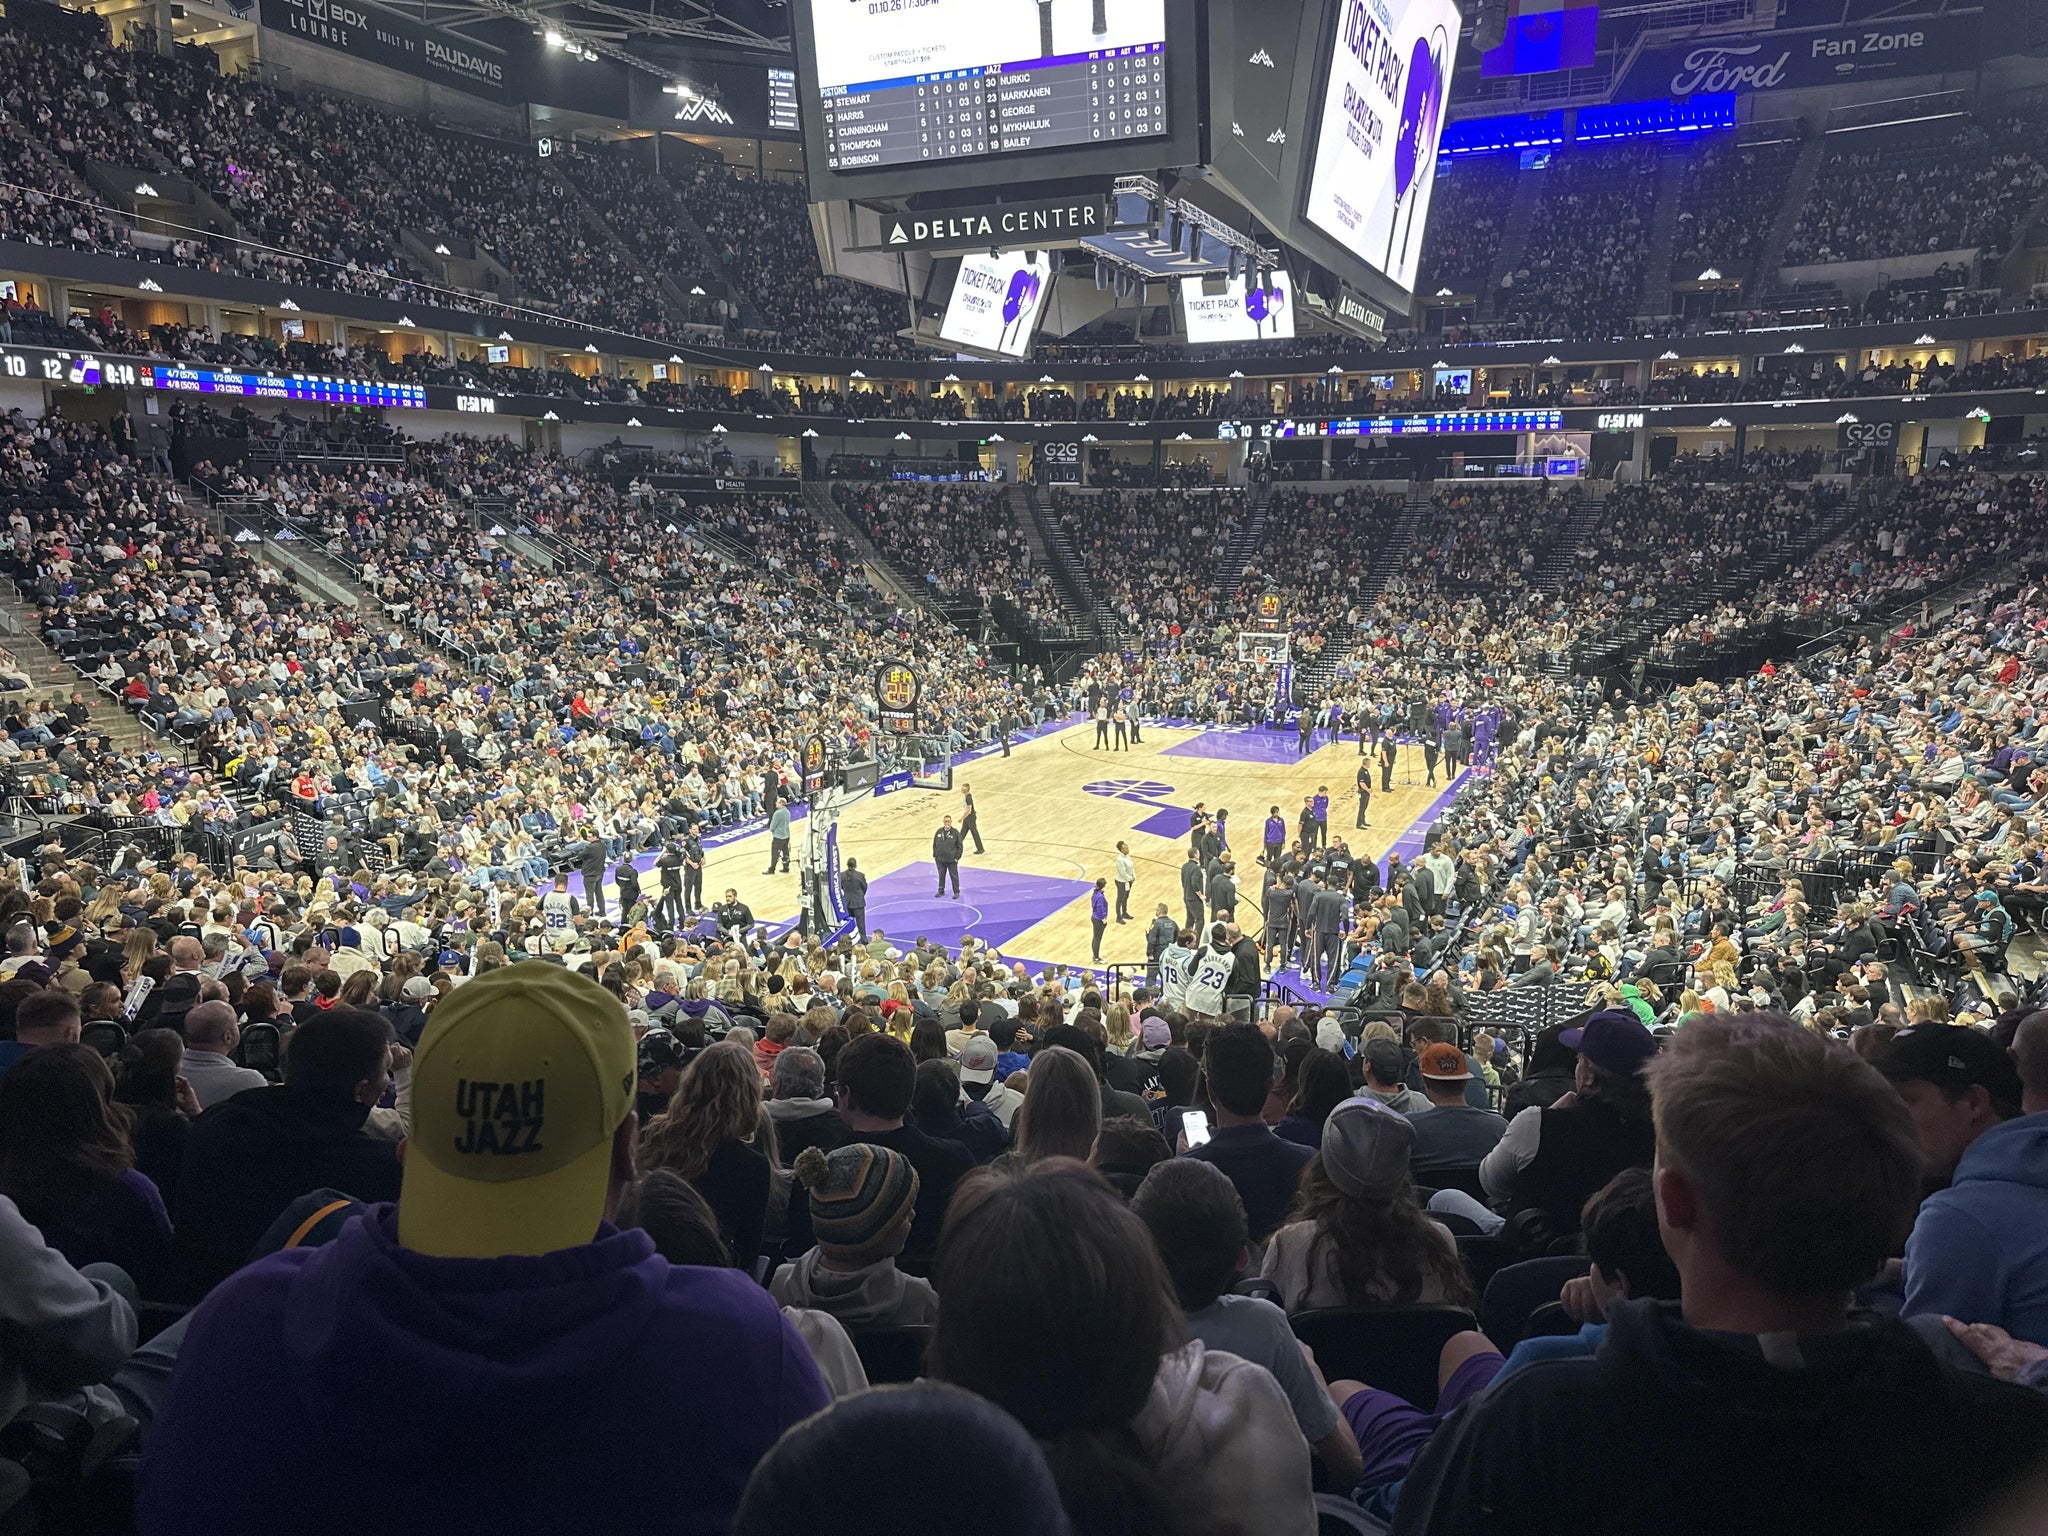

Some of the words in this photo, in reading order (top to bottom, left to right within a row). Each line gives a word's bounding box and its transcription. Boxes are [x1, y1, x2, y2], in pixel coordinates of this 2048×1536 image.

[330, 6, 368, 30] BOX
[868, 0, 901, 15] 01.10.26
[290, 13, 349, 46] LOUNGE
[376, 29, 401, 48] BUILT
[404, 40, 416, 52] BY
[1811, 38, 1857, 58] Fan
[1861, 31, 1925, 53] Zone
[984, 64, 1001, 75] JAZZ
[1089, 52, 1099, 60] PTS
[1121, 47, 1131, 56] AST
[985, 78, 996, 88] 30
[1000, 74, 1030, 86] NURKIC
[1135, 58, 1146, 68] 03
[1376, 36, 1404, 109] PACK
[1670, 44, 1791, 96] Ford
[820, 85, 848, 98] PISTONS
[823, 99, 833, 108] 28
[836, 95, 870, 107] STEWART
[959, 83, 968, 91] 01
[987, 93, 997, 103] 23
[1001, 87, 1051, 102] MARKKANEN
[1135, 75, 1147, 85] 03
[825, 114, 834, 123] 12
[837, 111, 864, 122] HARRIS
[959, 97, 970, 107] 03
[989, 109, 996, 119] 3
[1001, 105, 1036, 117] GEORGE
[1136, 91, 1147, 101] 03
[828, 129, 834, 138] 2
[839, 123, 889, 137] CUNNINGHAM
[960, 113, 970, 122] 03
[989, 124, 998, 134] 10
[1002, 119, 1050, 133] MYKHAILIUK
[1136, 108, 1148, 117] 03
[829, 144, 835, 152] 9
[840, 139, 881, 152] THOMPSON
[961, 128, 971, 137] 03
[989, 140, 999, 149] 19
[1003, 137, 1031, 148] BAILEY
[1136, 124, 1148, 133] 03
[828, 158, 838, 167] 55
[841, 154, 879, 166] ROBINSON
[961, 143, 972, 153] 03
[914, 215, 993, 241] DELTA
[1001, 206, 1096, 233] CENTER
[961, 267, 987, 289] TICKET
[985, 275, 1007, 295] PACK
[1189, 300, 1216, 310] TICKET
[1218, 298, 1240, 309] PACK
[1345, 299, 1366, 323] DELTA
[1364, 309, 1385, 333] CENTER
[4, 355, 26, 376] 10
[42, 358, 63, 379] 12
[105, 363, 135, 385] 8:14
[140, 365, 152, 376] 24
[481, 397, 495, 414] PM
[1240, 424, 1252, 437] 10
[1260, 424, 1272, 437] 12
[1297, 422, 1316, 436] 8:14
[1626, 413, 1644, 428] PM
[1846, 422, 1893, 440] G2G
[1044, 442, 1078, 457] G2G
[1261, 602, 1277, 615] 24
[887, 682, 910, 703] 24
[890, 711, 915, 719] TISSOT
[833, 871, 845, 913] AMERICA
[546, 912, 567, 928] 32
[1164, 965, 1178, 984] 19
[1200, 966, 1225, 990] 23
[456, 1077, 545, 1121] UTAH
[454, 1117, 543, 1155] JAZZ
